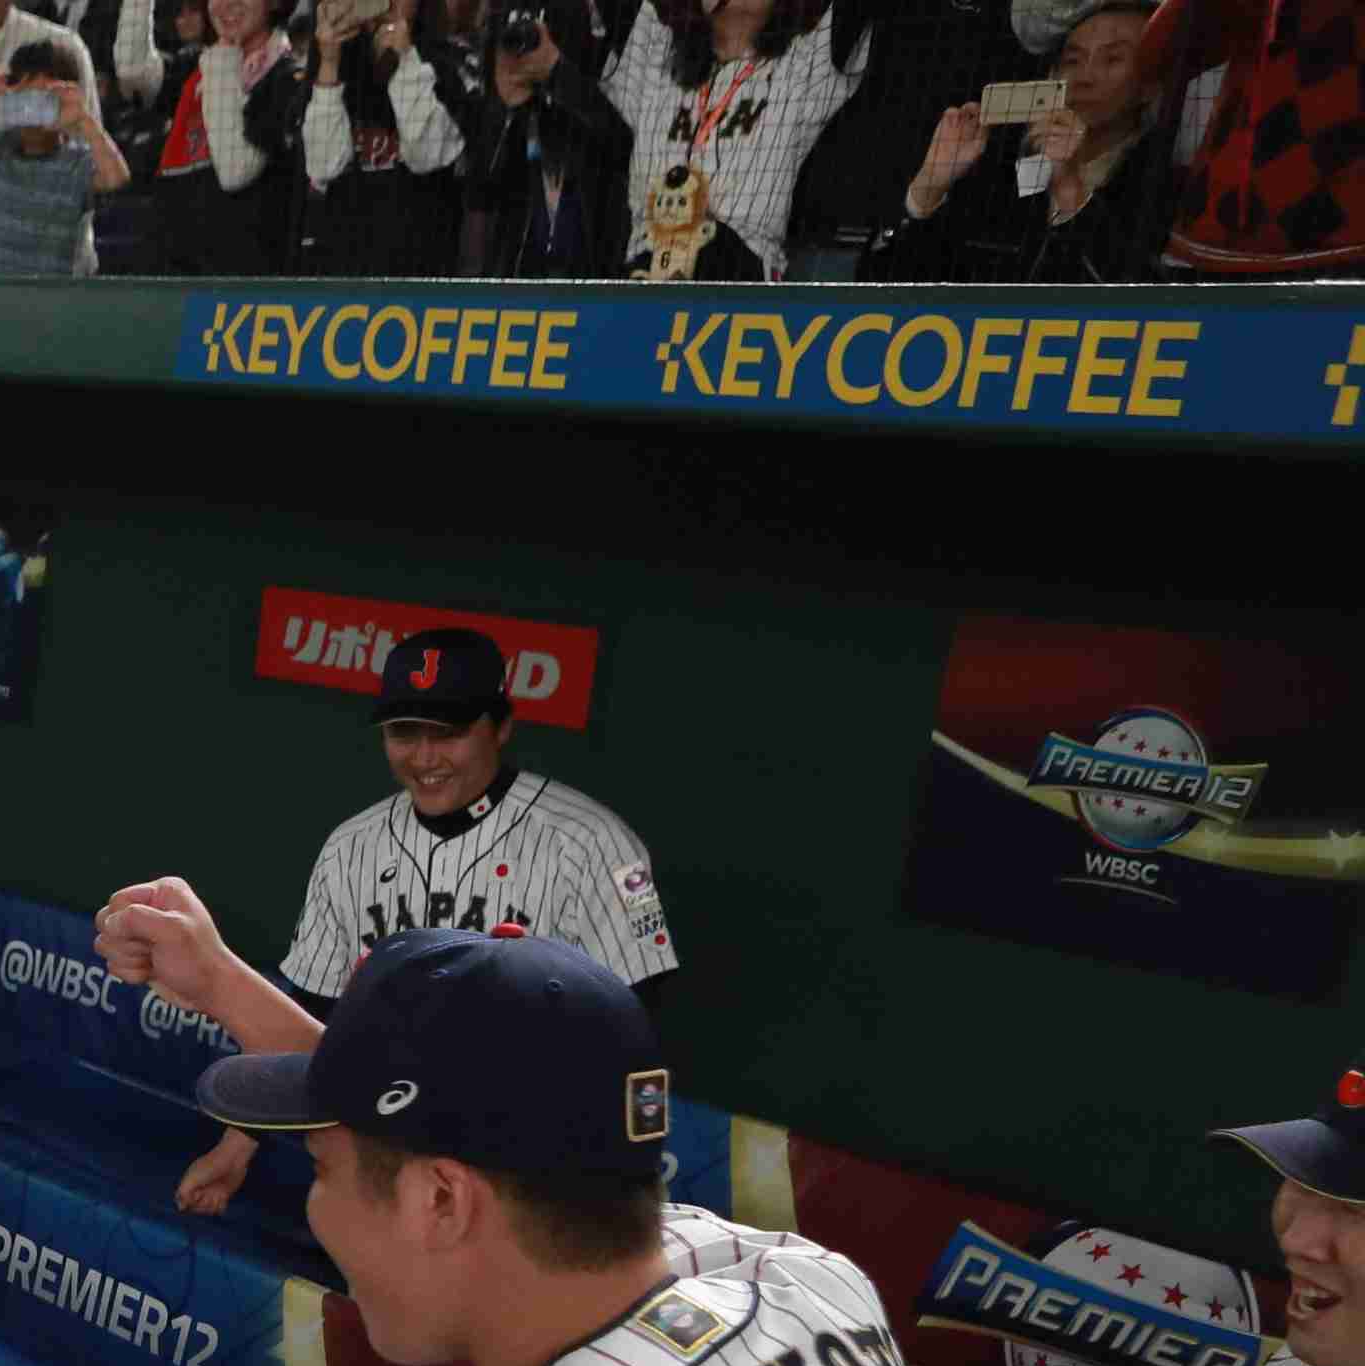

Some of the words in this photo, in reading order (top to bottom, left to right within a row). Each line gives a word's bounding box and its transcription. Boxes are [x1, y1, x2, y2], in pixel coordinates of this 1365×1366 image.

[409, 649, 442, 690] J
[1084, 851, 1161, 885] WBSC
[0, 940, 125, 1015] @WBSC
